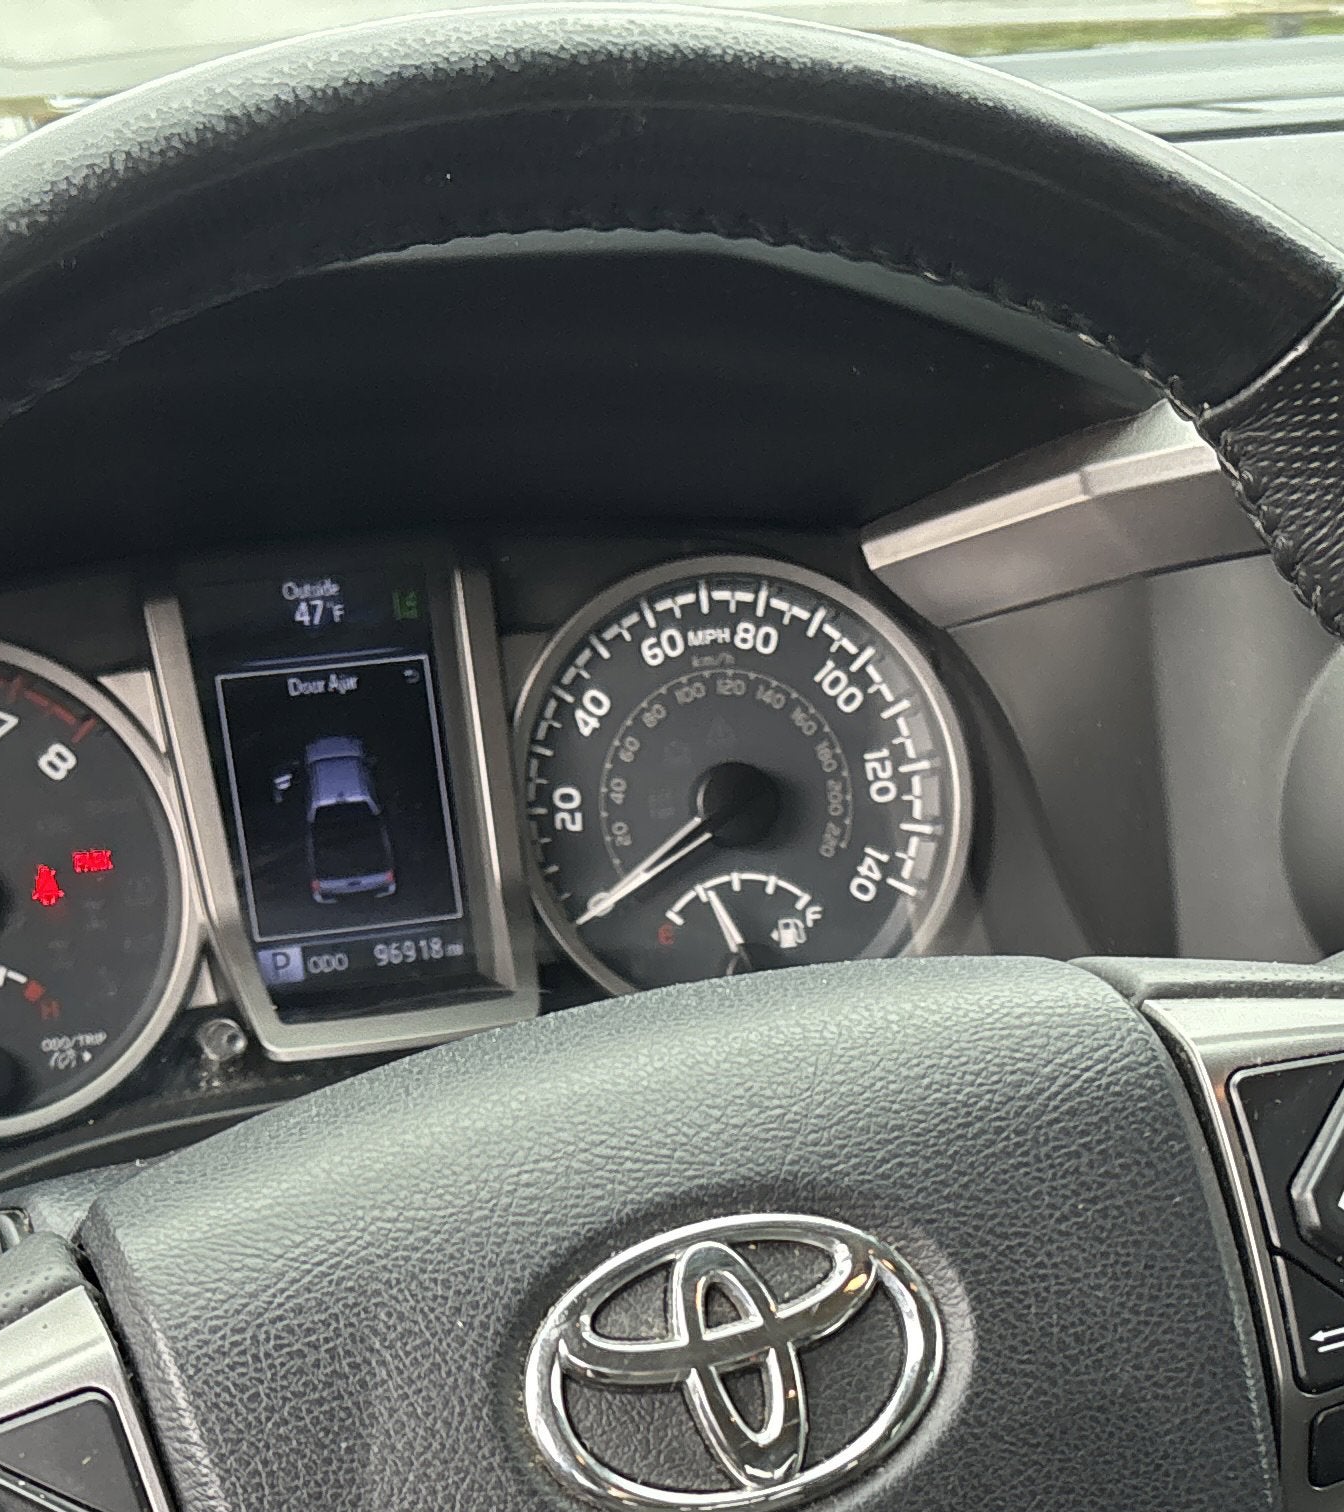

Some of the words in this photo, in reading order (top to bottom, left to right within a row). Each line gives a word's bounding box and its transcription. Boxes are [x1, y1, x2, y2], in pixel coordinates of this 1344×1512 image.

[640, 629, 685, 667] 60
[688, 627, 731, 648] MPH
[733, 622, 780, 655] 80
[716, 679, 747, 696] 120
[813, 659, 864, 714] 100
[573, 689, 611, 737] 40
[38, 743, 78, 781] 8
[862, 748, 898, 803] 120
[552, 786, 584, 833] 20
[848, 847, 890, 903] 140
[658, 924, 676, 946] E
[804, 905, 824, 928] F
[271, 951, 291, 978] P
